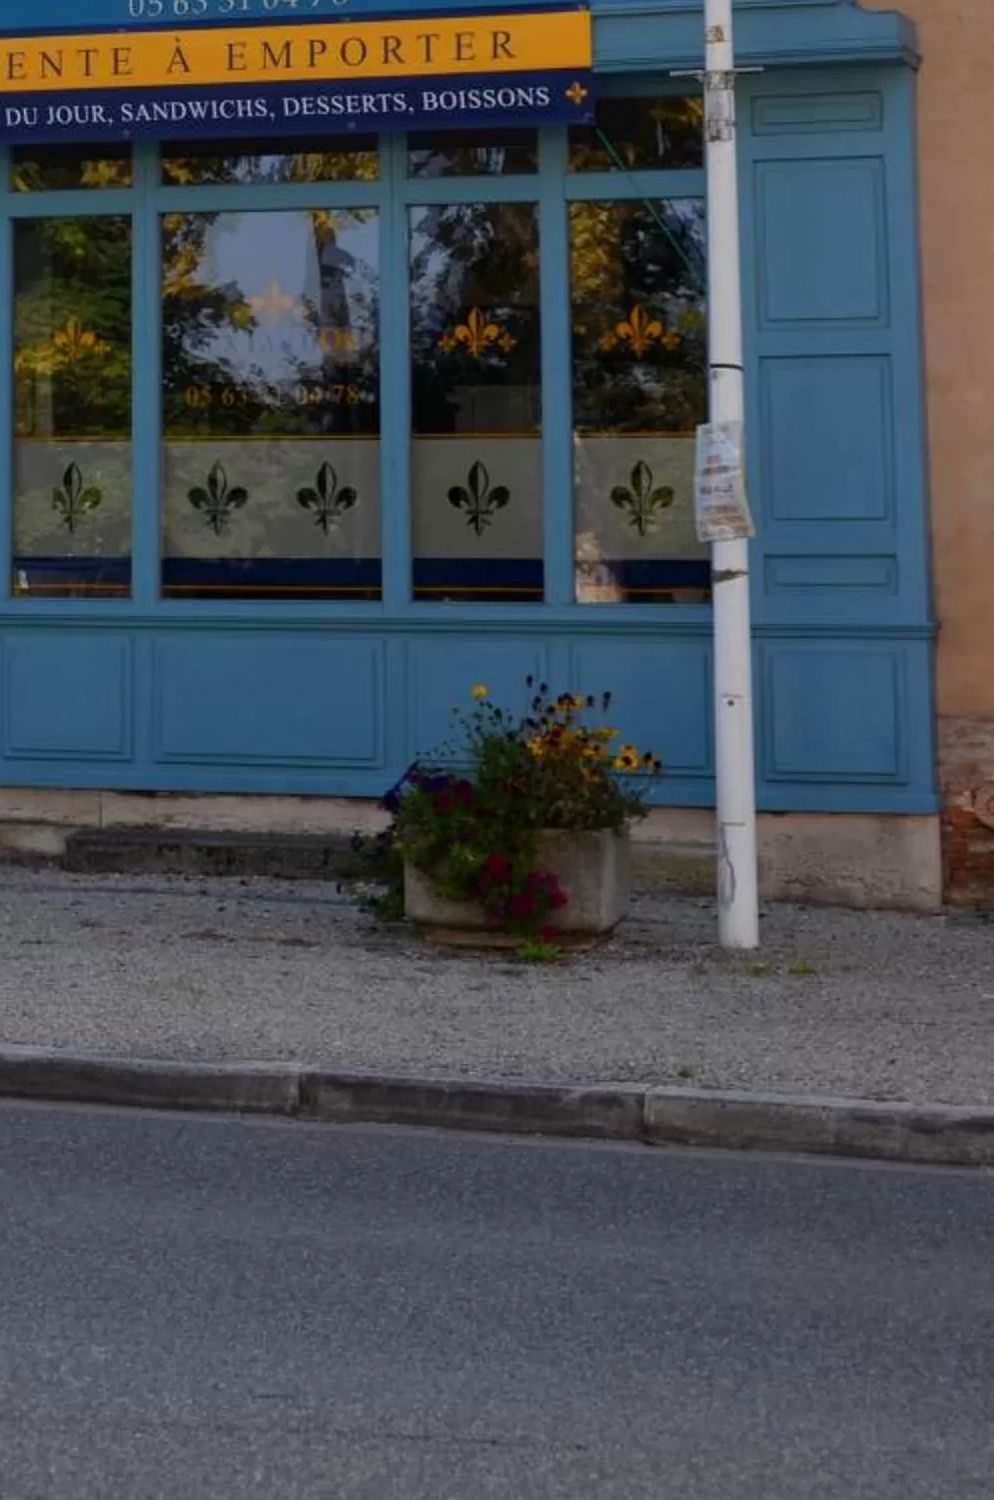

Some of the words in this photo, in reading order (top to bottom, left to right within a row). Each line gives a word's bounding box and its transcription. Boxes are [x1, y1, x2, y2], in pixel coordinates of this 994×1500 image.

[166, 36, 191, 74] À
[226, 30, 517, 72] EMPORTER
[6, 107, 38, 127] DU
[46, 104, 114, 125] JOUR,
[121, 99, 276, 122] SANDWICHS,
[283, 92, 415, 117] DESSERTS,
[422, 86, 551, 111] BOISSONS
